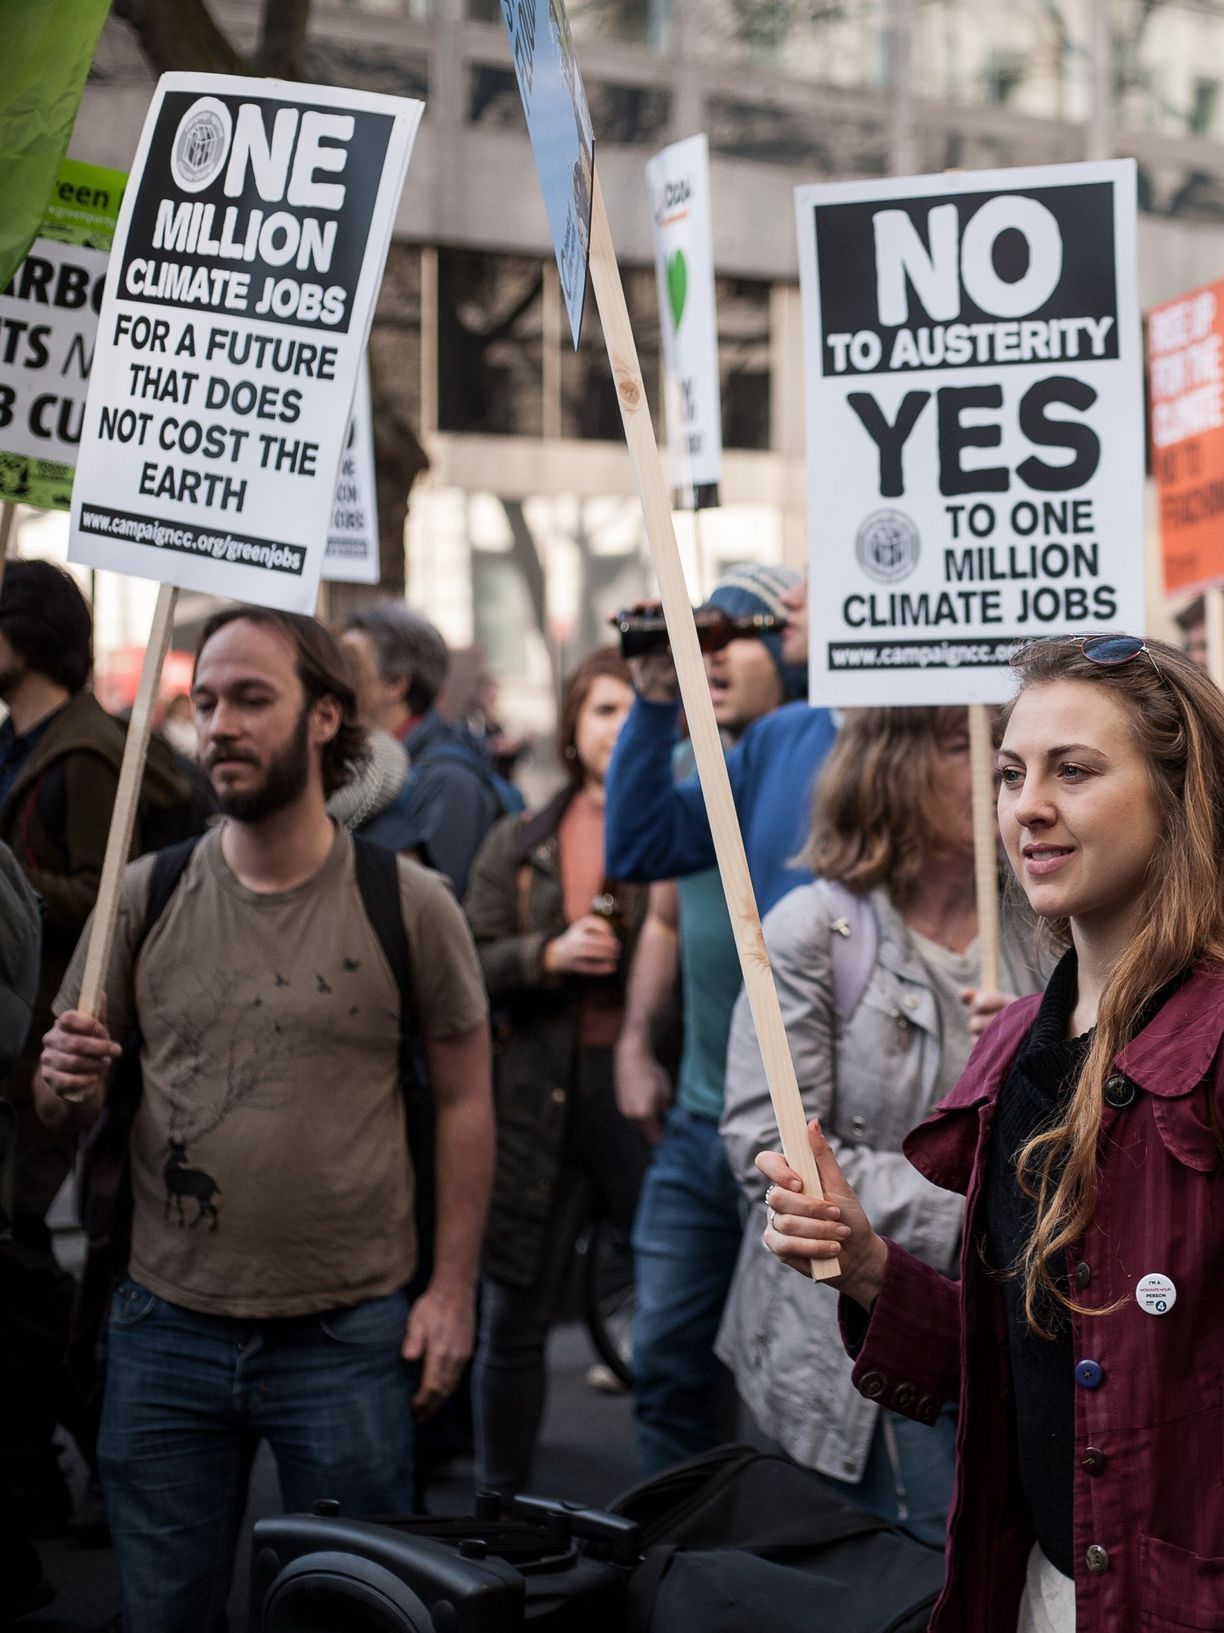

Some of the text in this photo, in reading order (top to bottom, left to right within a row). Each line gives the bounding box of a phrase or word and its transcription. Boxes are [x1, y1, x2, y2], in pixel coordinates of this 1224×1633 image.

[170, 96, 355, 211] ONE
[56, 180, 110, 209] een
[151, 199, 338, 274] MILLION
[873, 195, 1063, 327] NO
[2, 257, 106, 315] RB
[124, 258, 347, 326] CLIMATE JOBS
[0, 318, 52, 371] TS
[113, 314, 339, 381] FOR A FUTURE
[828, 316, 1114, 372] TO AUSTERITY
[129, 363, 303, 424] THAT DOES
[99, 406, 153, 448] NOT
[158, 421, 248, 462] COST
[260, 436, 319, 477] THE
[847, 376, 1101, 498] YES
[139, 462, 247, 513] EARTH
[82, 511, 301, 570] www.campaigncc.org/greenjobs
[945, 500, 1094, 540] TO ONE
[944, 543, 1098, 582] MILLION
[843, 585, 1117, 628] CLIMATE JOBS
